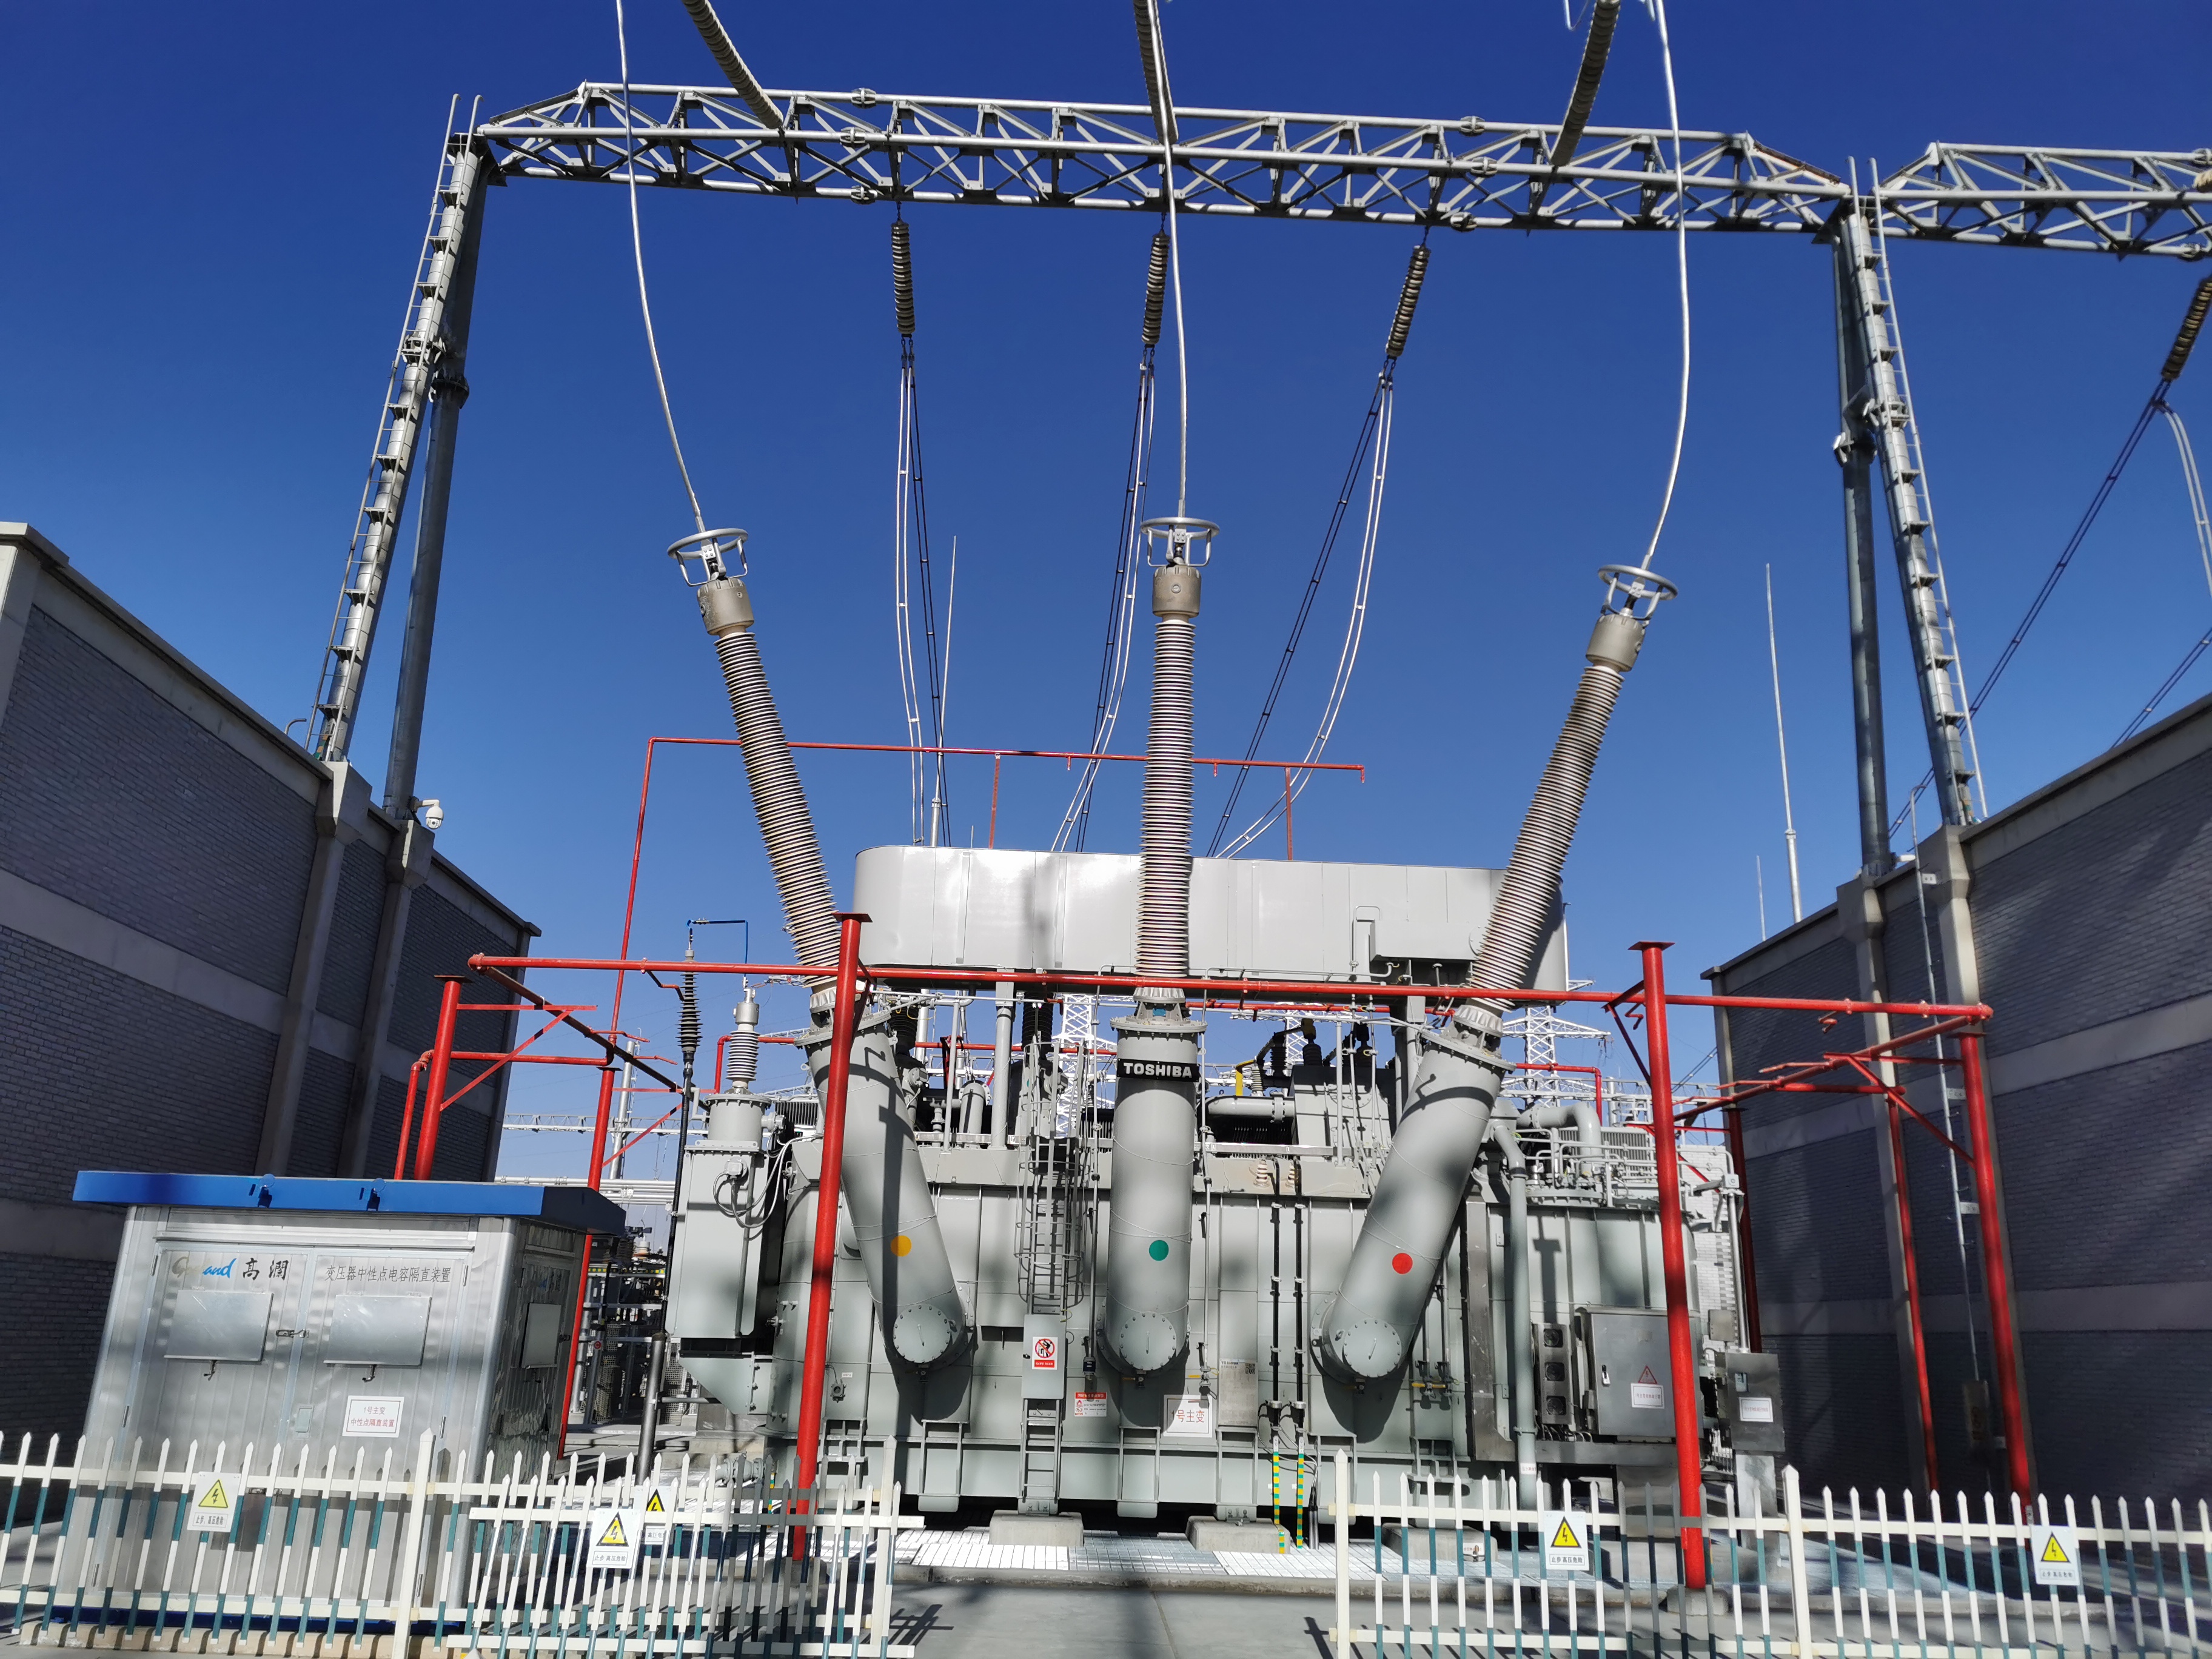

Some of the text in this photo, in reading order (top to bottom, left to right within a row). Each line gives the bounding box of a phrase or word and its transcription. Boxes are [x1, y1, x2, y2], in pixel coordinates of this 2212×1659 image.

[1123, 1062, 1193, 1078] TOSHIBA
[324, 1264, 451, 1283] 变压器中性点电容隔直装置
[364, 1406, 386, 1415] 1号主变
[1171, 1409, 1205, 1423] 1号主变
[350, 1418, 395, 1427] 中性点隔直装置
